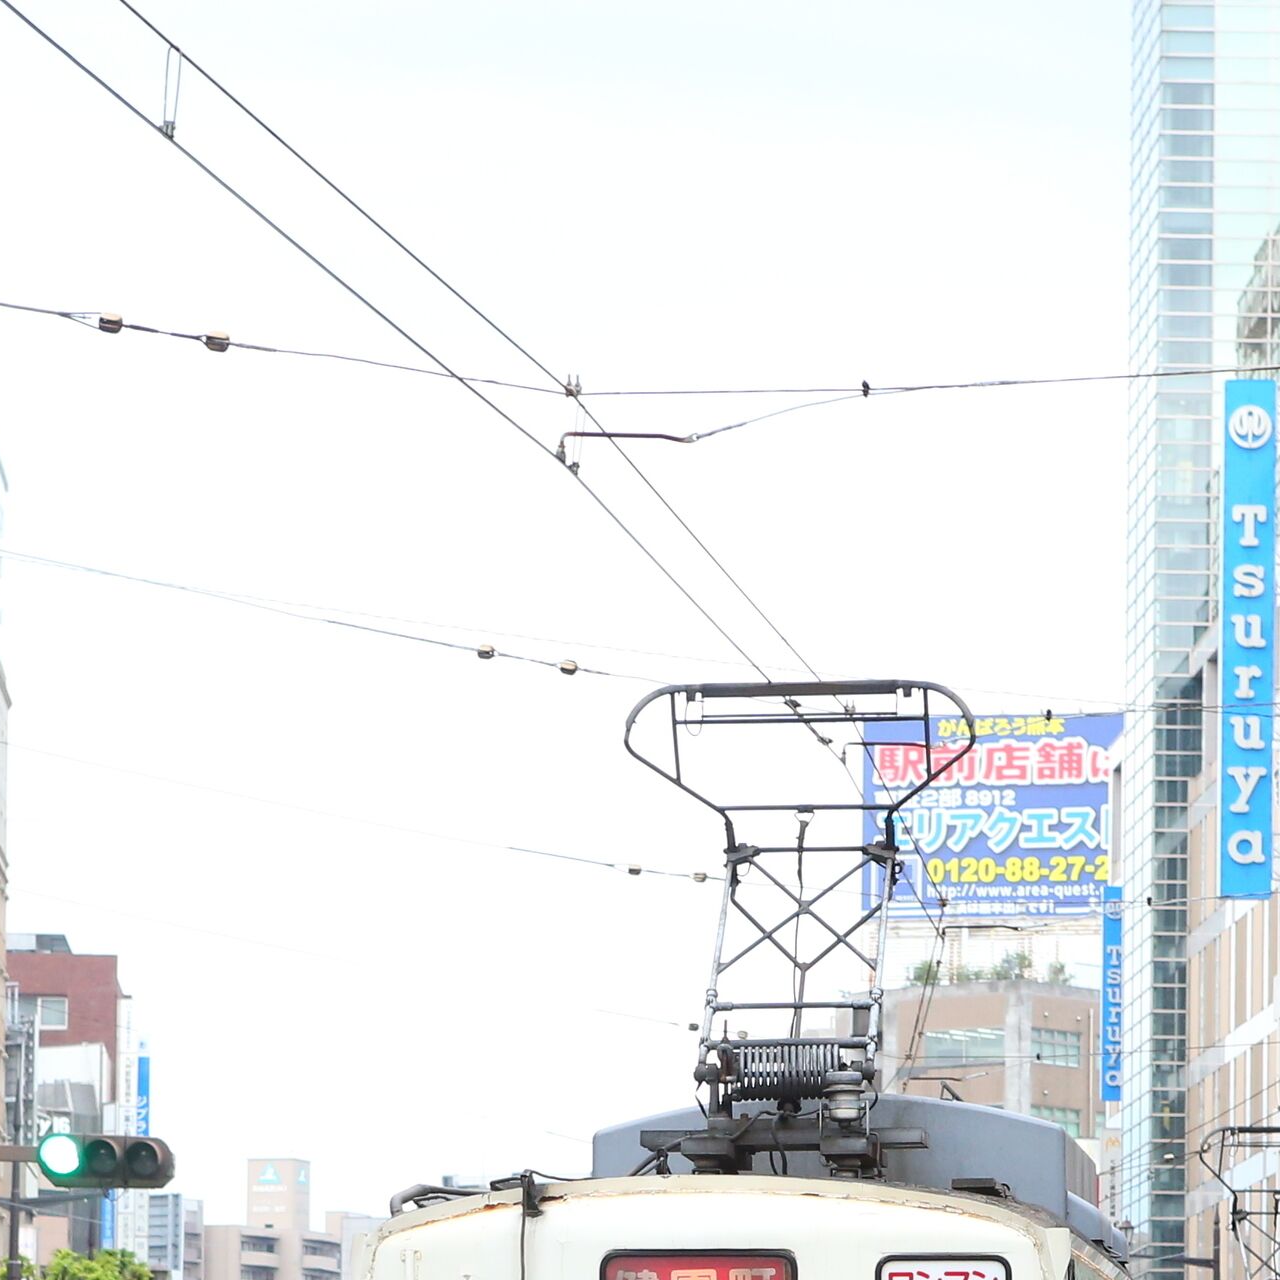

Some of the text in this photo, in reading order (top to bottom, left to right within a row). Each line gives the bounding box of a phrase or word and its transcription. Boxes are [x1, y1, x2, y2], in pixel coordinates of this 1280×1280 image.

[1228, 503, 1268, 866] Tsuruya
[938, 717, 1065, 736] がんばろう熊本
[965, 789, 1017, 806] 8912
[1105, 946, 1121, 1088] Tsuruya
